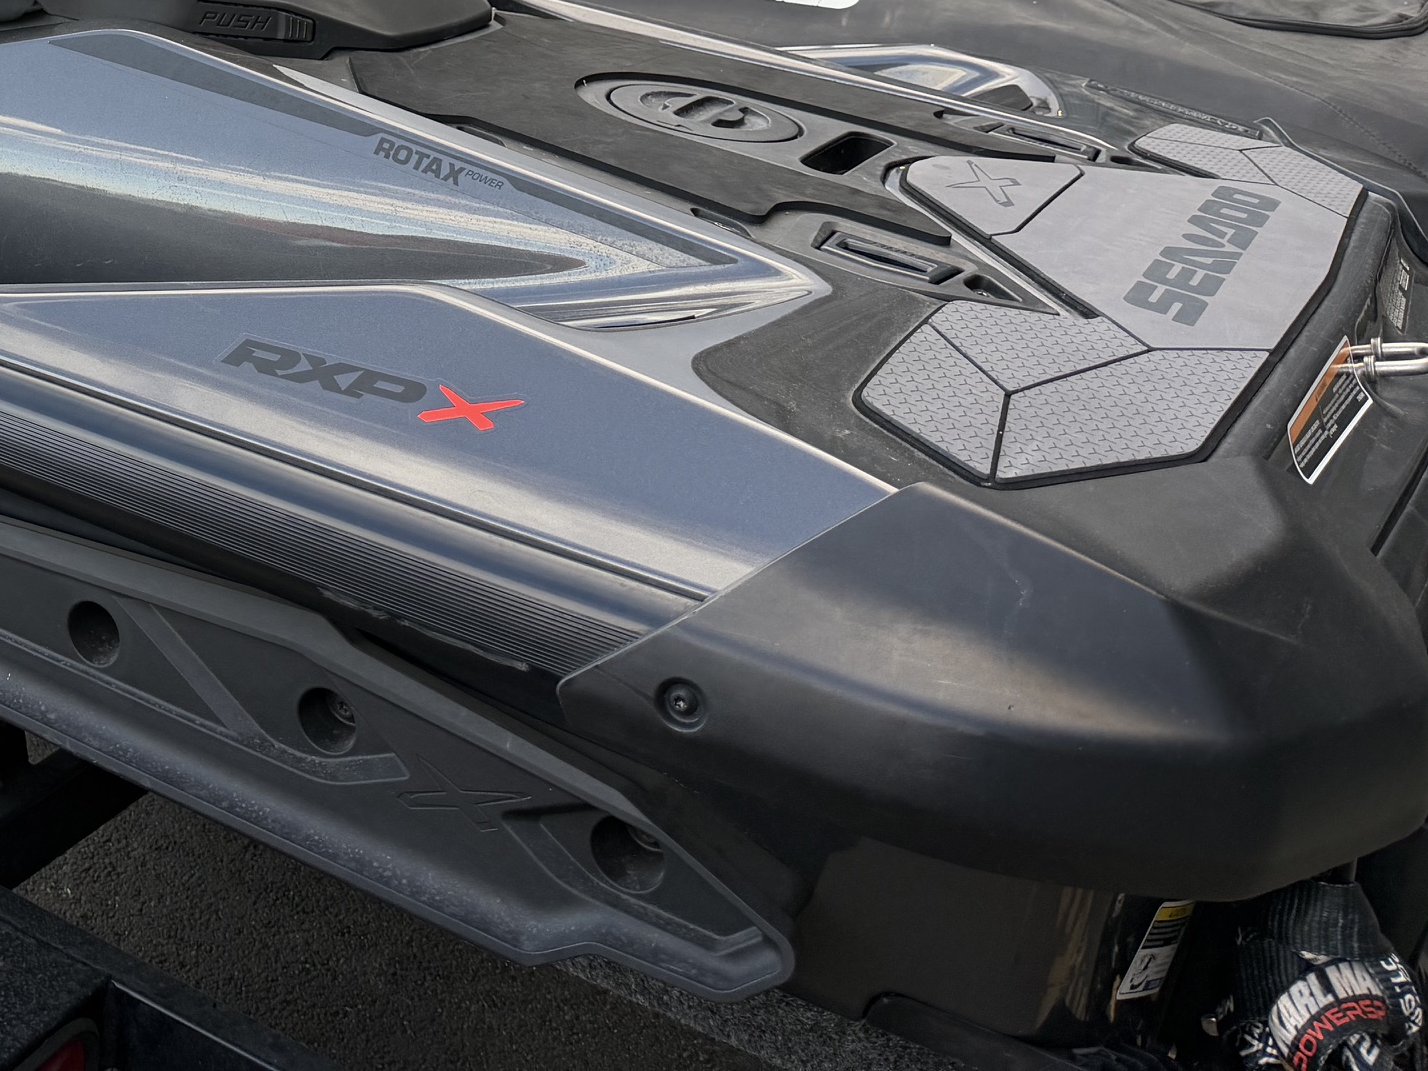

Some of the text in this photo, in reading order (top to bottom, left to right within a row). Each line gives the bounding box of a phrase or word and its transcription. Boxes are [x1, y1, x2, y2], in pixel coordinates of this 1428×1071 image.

[199, 10, 272, 32] PUSH
[373, 136, 505, 191] ROTAX POWER
[220, 338, 526, 432] RXP X
[1268, 972, 1335, 1059] KARL
